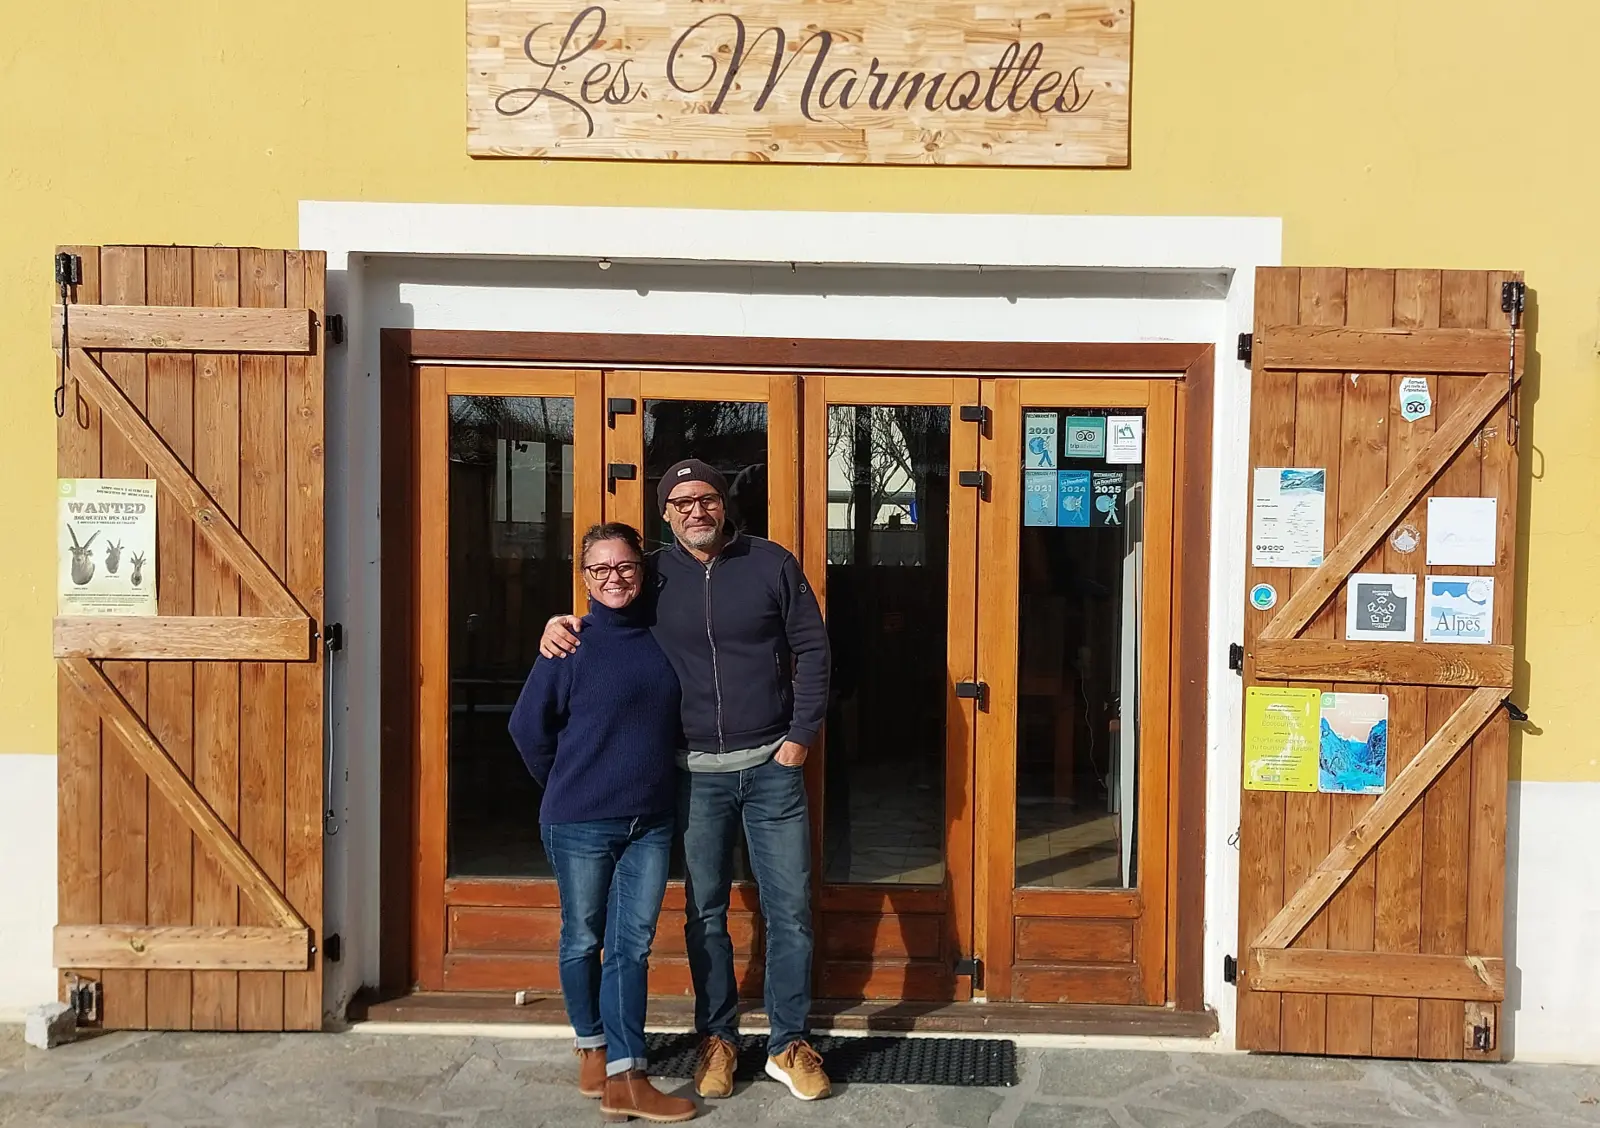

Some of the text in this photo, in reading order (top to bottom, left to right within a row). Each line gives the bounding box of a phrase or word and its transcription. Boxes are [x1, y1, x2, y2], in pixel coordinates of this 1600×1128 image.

[495, 5, 1094, 137] Les Marmottes
[1028, 427, 1056, 435] 2020
[1094, 485, 1122, 494] 2025
[67, 502, 147, 514] WANTED
[1436, 611, 1481, 636] Alpes
